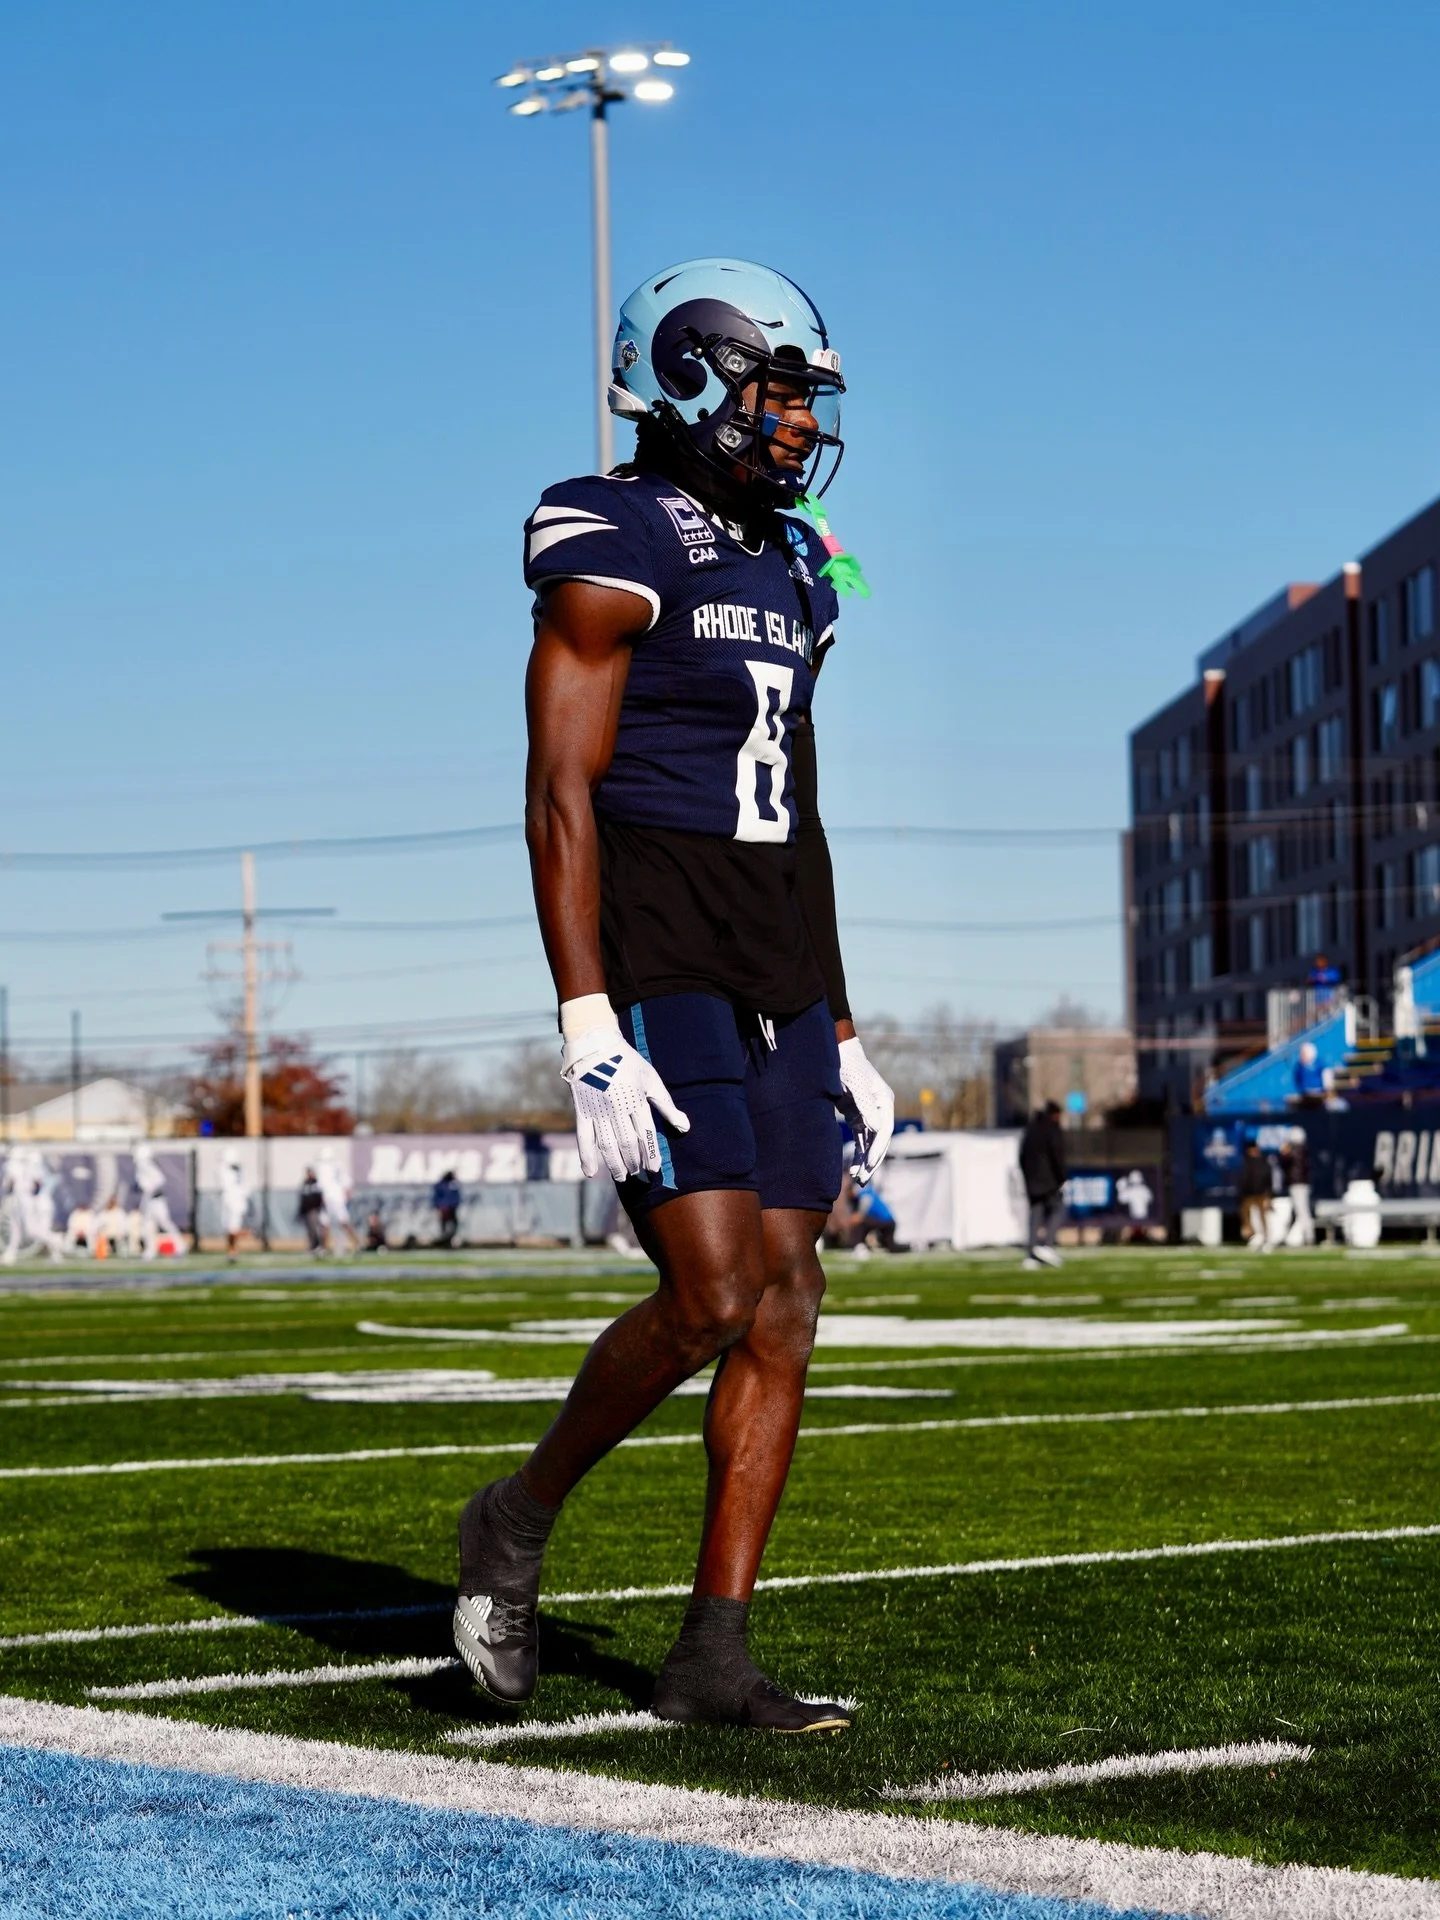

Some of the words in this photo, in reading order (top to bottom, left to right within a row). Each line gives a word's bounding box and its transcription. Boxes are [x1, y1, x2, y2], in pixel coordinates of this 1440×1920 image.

[689, 547, 719, 564] CAA
[693, 604, 761, 643] RHODE
[733, 660, 794, 843] 8
[645, 1129, 657, 1160] ADIZERO
